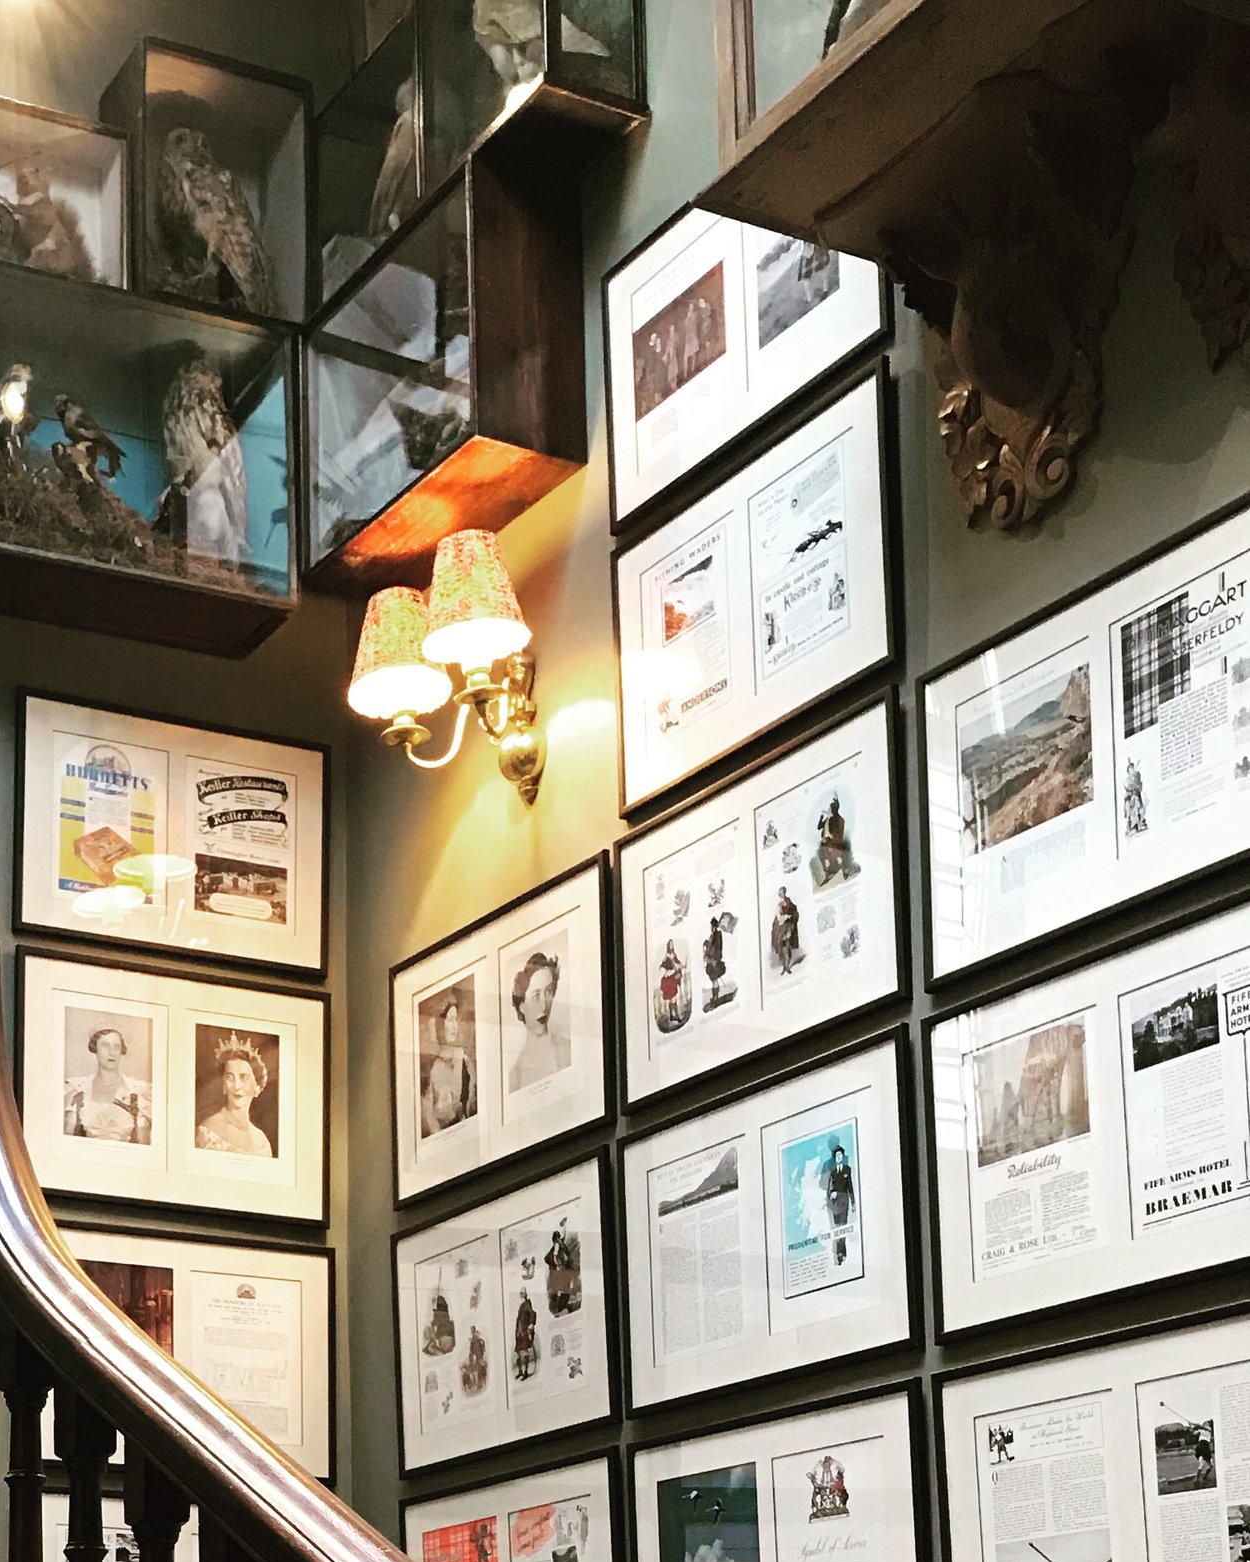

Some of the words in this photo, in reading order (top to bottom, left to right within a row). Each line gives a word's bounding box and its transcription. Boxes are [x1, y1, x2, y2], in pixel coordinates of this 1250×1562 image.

[688, 533, 720, 558] WADERS
[1171, 611, 1244, 656] ABERFELDY
[1007, 1154, 1061, 1179] Reliability
[1144, 1176, 1166, 1190] FIFE
[1170, 1169, 1196, 1182] ARMS
[1199, 1159, 1232, 1174] HOTEL
[1145, 1180, 1232, 1215] BRAEMAR
[821, 1232, 831, 1241] FOR
[834, 1225, 854, 1238] SERVICE
[981, 1245, 1006, 1261] CRAIG
[1009, 1245, 1015, 1254] &
[1018, 1238, 1039, 1251] ROSE
